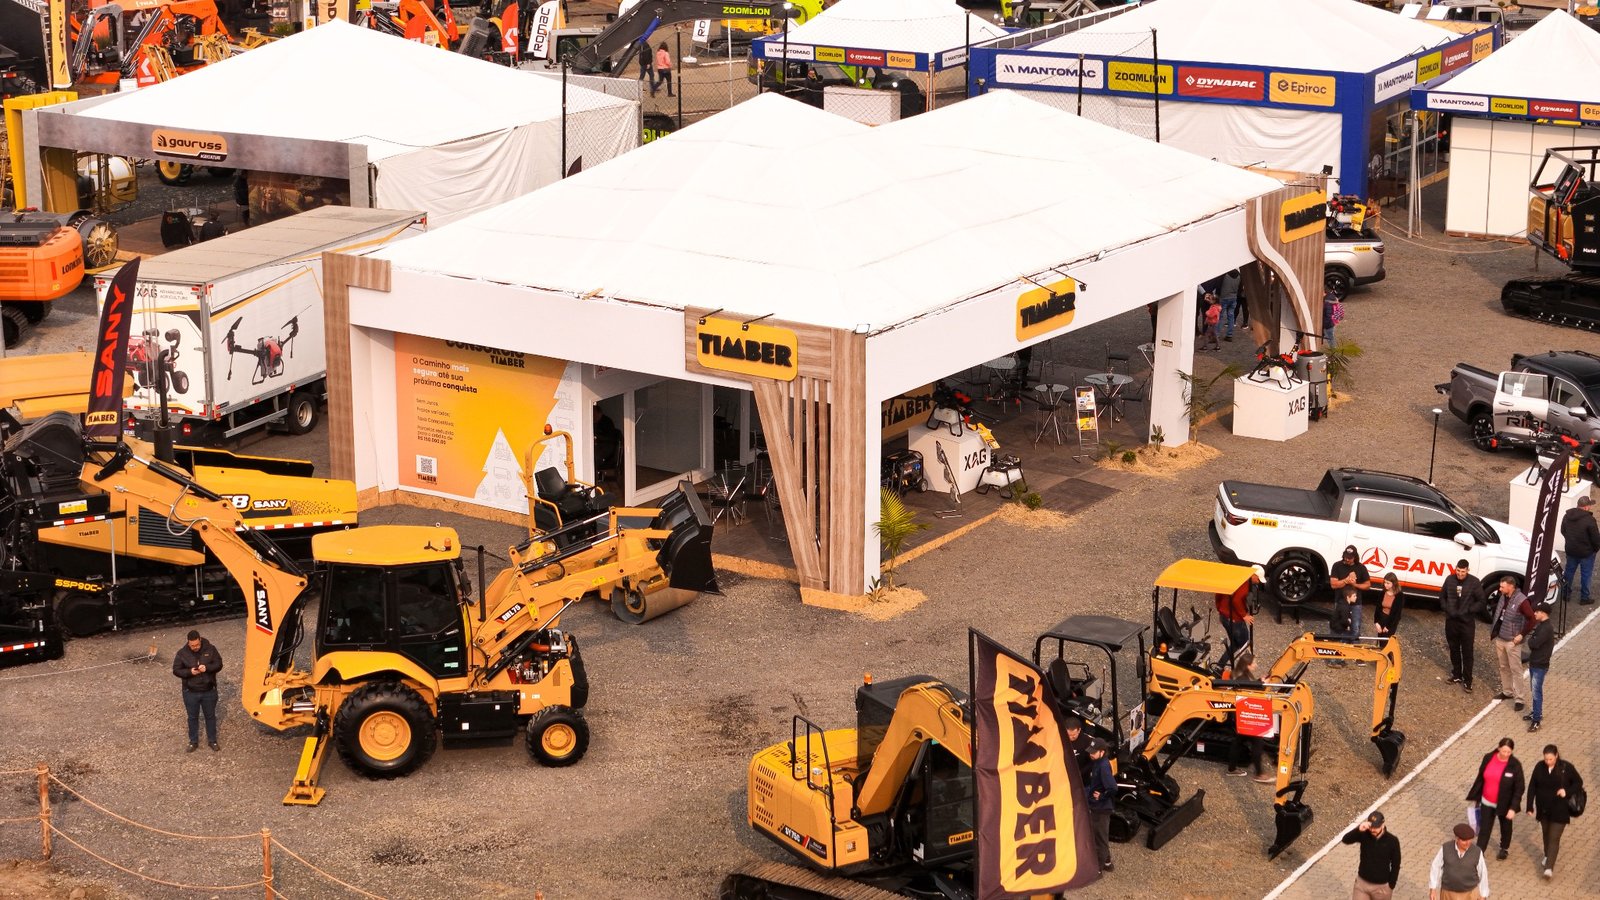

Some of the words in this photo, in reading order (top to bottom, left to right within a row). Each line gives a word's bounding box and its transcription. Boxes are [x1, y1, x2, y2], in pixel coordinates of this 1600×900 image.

[723, 6, 770, 15] ZOOMLION
[1018, 66, 1096, 78] MANTOMAC
[1420, 62, 1439, 76] ZOOMLION
[1196, 77, 1256, 88] DYNAPAC
[1384, 70, 1414, 90] MANTOMAC
[1291, 81, 1327, 94] Epiroc
[1439, 99, 1484, 107] MANTOMAC
[169, 138, 222, 151] gauruss
[137, 287, 157, 298] XAG
[1021, 292, 1076, 328] TIMBER
[96, 285, 126, 398] SANY
[699, 332, 792, 367] TIMBER
[419, 358, 450, 370] Caminho
[451, 363, 470, 373] mais
[490, 355, 525, 368] TIMBER
[413, 367, 438, 377] seguro
[438, 370, 450, 379] até
[413, 376, 441, 388] próxima
[442, 382, 478, 394] conquista
[1288, 396, 1306, 416] XAG
[965, 448, 986, 471] XAG
[253, 500, 287, 508] SANY
[1253, 518, 1277, 527] TIMBER
[1393, 556, 1456, 576] SANY
[257, 590, 268, 625] SANY
[1007, 673, 1056, 880] TIMBER
[950, 832, 972, 843] TIMBER
